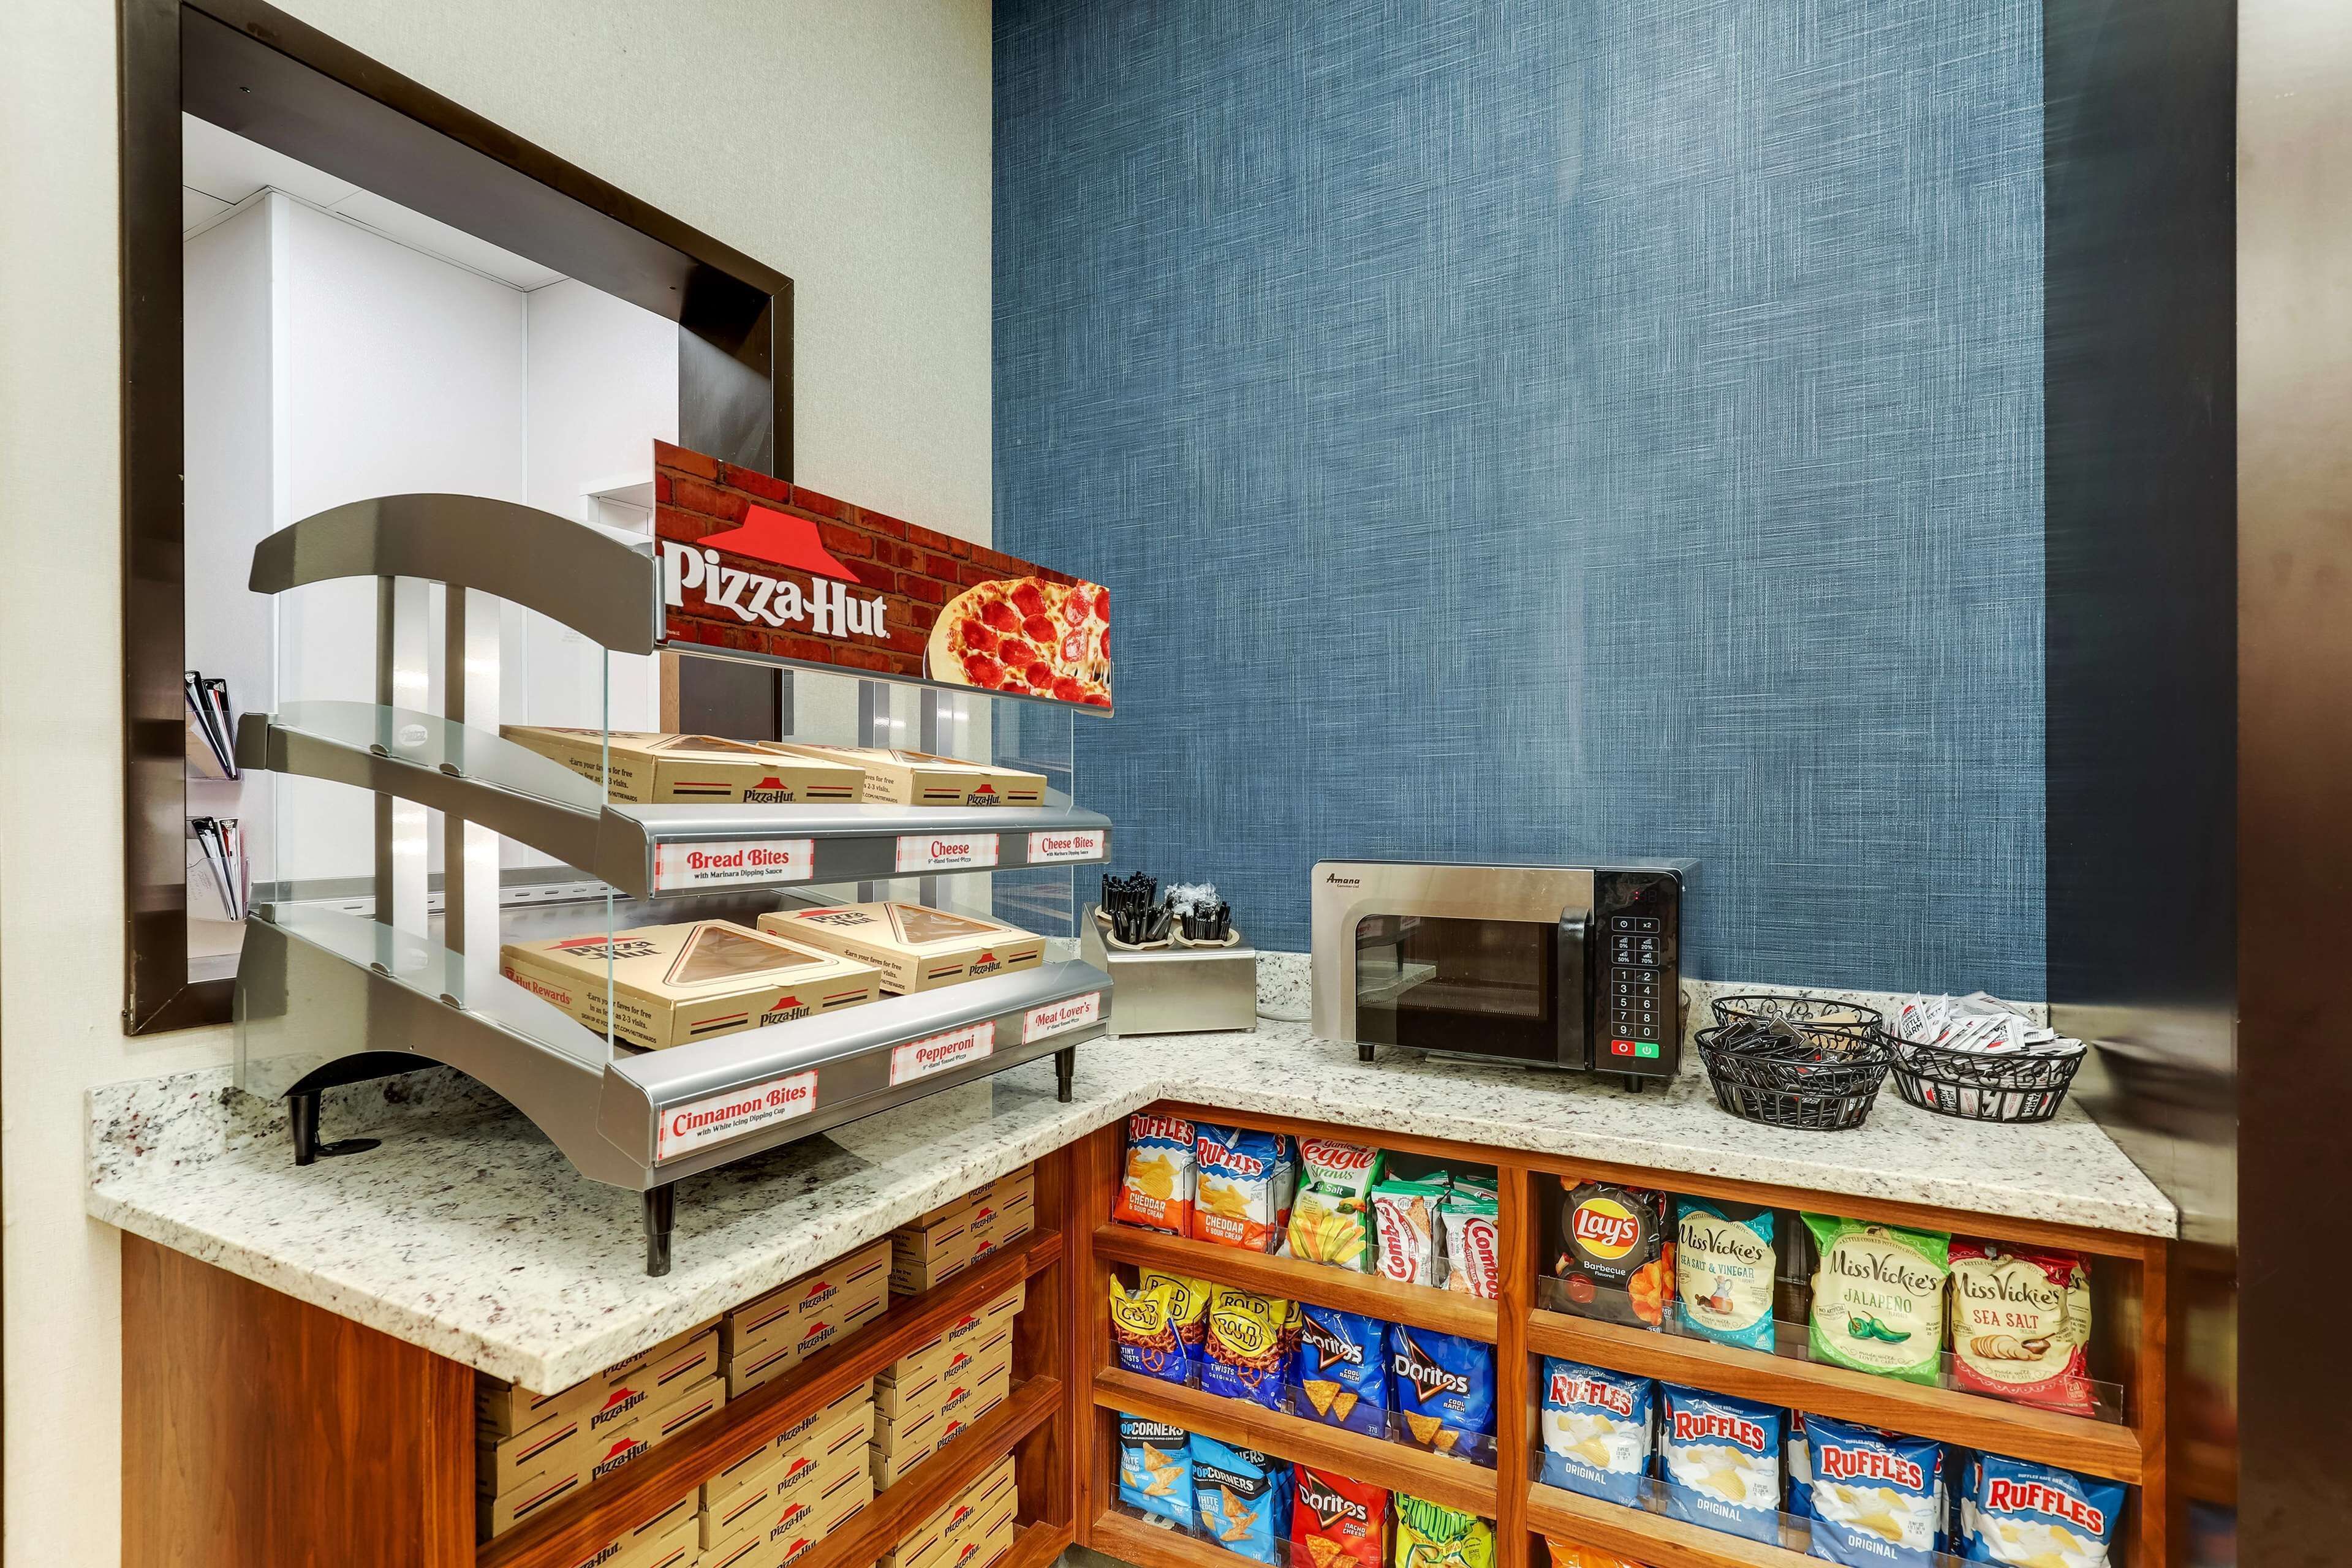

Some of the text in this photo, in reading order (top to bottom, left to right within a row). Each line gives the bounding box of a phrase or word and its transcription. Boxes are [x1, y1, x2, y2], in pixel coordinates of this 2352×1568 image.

[662, 540, 888, 638] Pizza Hut
[569, 758, 583, 766] Earn
[621, 769, 632, 777] free
[613, 780, 629, 788] visits.
[743, 790, 793, 803] Pizza Hut
[967, 794, 1000, 804] Pizza Hut
[931, 840, 969, 858] Cheese
[1042, 837, 1094, 853] Cheese Bites
[687, 849, 789, 869] Bread Bites
[709, 869, 739, 878] Marinara
[1326, 873, 1360, 884] Amana
[807, 912, 868, 923] Pizza
[561, 941, 662, 960] Pizza Hut
[844, 949, 857, 958] Earn
[969, 960, 1000, 976] Pizza Hut
[1622, 971, 1627, 979] 1
[1644, 972, 1651, 981] 2
[533, 982, 570, 1005] Rewards
[1620, 984, 1627, 993] 3
[1644, 986, 1651, 995] 4
[587, 992, 600, 1003] Earn
[617, 1001, 630, 1012] faves
[640, 1009, 651, 1019] free
[1620, 998, 1627, 1006] 5
[1644, 1000, 1651, 1008] 6
[622, 1014, 631, 1023] 2-3
[632, 1018, 647, 1029] visits.
[760, 1006, 810, 1027] Pizza Hut
[1035, 1001, 1089, 1027] Meat Lover's
[1644, 1014, 1651, 1022] 8
[1620, 1025, 1627, 1034] 9
[1644, 1027, 1651, 1036] 0
[1903, 1016, 1921, 1032] LITTLE
[1905, 1023, 1924, 1039] PARM
[916, 1035, 974, 1063] Pepperoni
[673, 1087, 806, 1137] Cinnamon Bites
[697, 1107, 785, 1137] with White Icing Dipping Cup
[1129, 1114, 1194, 1146] RUFFLES
[1197, 1137, 1263, 1175] RUFFLES
[1311, 1165, 1354, 1180] Straws
[1325, 1185, 1344, 1195] Salt
[1130, 1193, 1166, 1210] CHEDDAR
[1134, 1204, 1146, 1215] SOUR
[1147, 1208, 1163, 1219] CREAM
[1205, 1215, 1244, 1234] CHEDDAR
[1210, 1227, 1224, 1237] SOUR
[1225, 1231, 1242, 1241] CREAM
[1576, 1210, 1635, 1246] Lay's
[1677, 1224, 1763, 1263] Miss Vickie's
[1882, 1239, 1902, 1250] POTATO
[1902, 1246, 1918, 1257] CHIPS
[1584, 1261, 1626, 1275] Barbecue
[1681, 1254, 1754, 1278] SEA SALT & VINEGAR
[1829, 1250, 1938, 1297] Miss Vickie's
[1844, 1288, 1912, 1313] JALAPEÑO
[1987, 1271, 2059, 1311] Vickie's
[1225, 1297, 1265, 1315] ROLD
[966, 1318, 980, 1330] Hut
[1973, 1309, 2038, 1329] SEA SALT
[1302, 1329, 1363, 1365] Doritos
[944, 1355, 972, 1381] Pizza Hut
[1211, 1363, 1235, 1376] TWISTS
[1339, 1372, 1360, 1382] RANCH
[1395, 1354, 1469, 1393] Doritos
[1209, 1373, 1236, 1384] ORIGINAL
[941, 1390, 970, 1416] Pizza Hut
[1449, 1398, 1465, 1407] COOL
[1551, 1376, 1632, 1415] RUFFLES
[591, 1391, 645, 1431] Pizza Hut
[1443, 1402, 1465, 1412] RANCH
[777, 1414, 817, 1447] Pizza Hut
[1676, 1412, 1763, 1450] RUFFLES
[592, 1440, 648, 1482] Pizza Hut
[1823, 1447, 1921, 1488] RUFFLES
[777, 1461, 817, 1494] Pizza Hut
[1565, 1463, 1606, 1485] ORIGINAL
[1298, 1483, 1367, 1520] Doritos
[1697, 1498, 1742, 1522] ORIGINAL
[1989, 1480, 2101, 1533] RUFFLES
[770, 1505, 811, 1542] Pizza Hut
[945, 1507, 974, 1537] Pizza Hut
[1398, 1491, 1478, 1544] FUNYUNS
[1343, 1528, 1366, 1538] CHEESE
[1345, 1523, 1366, 1533] NACHO
[1848, 1536, 1897, 1560] ORIGINAL
